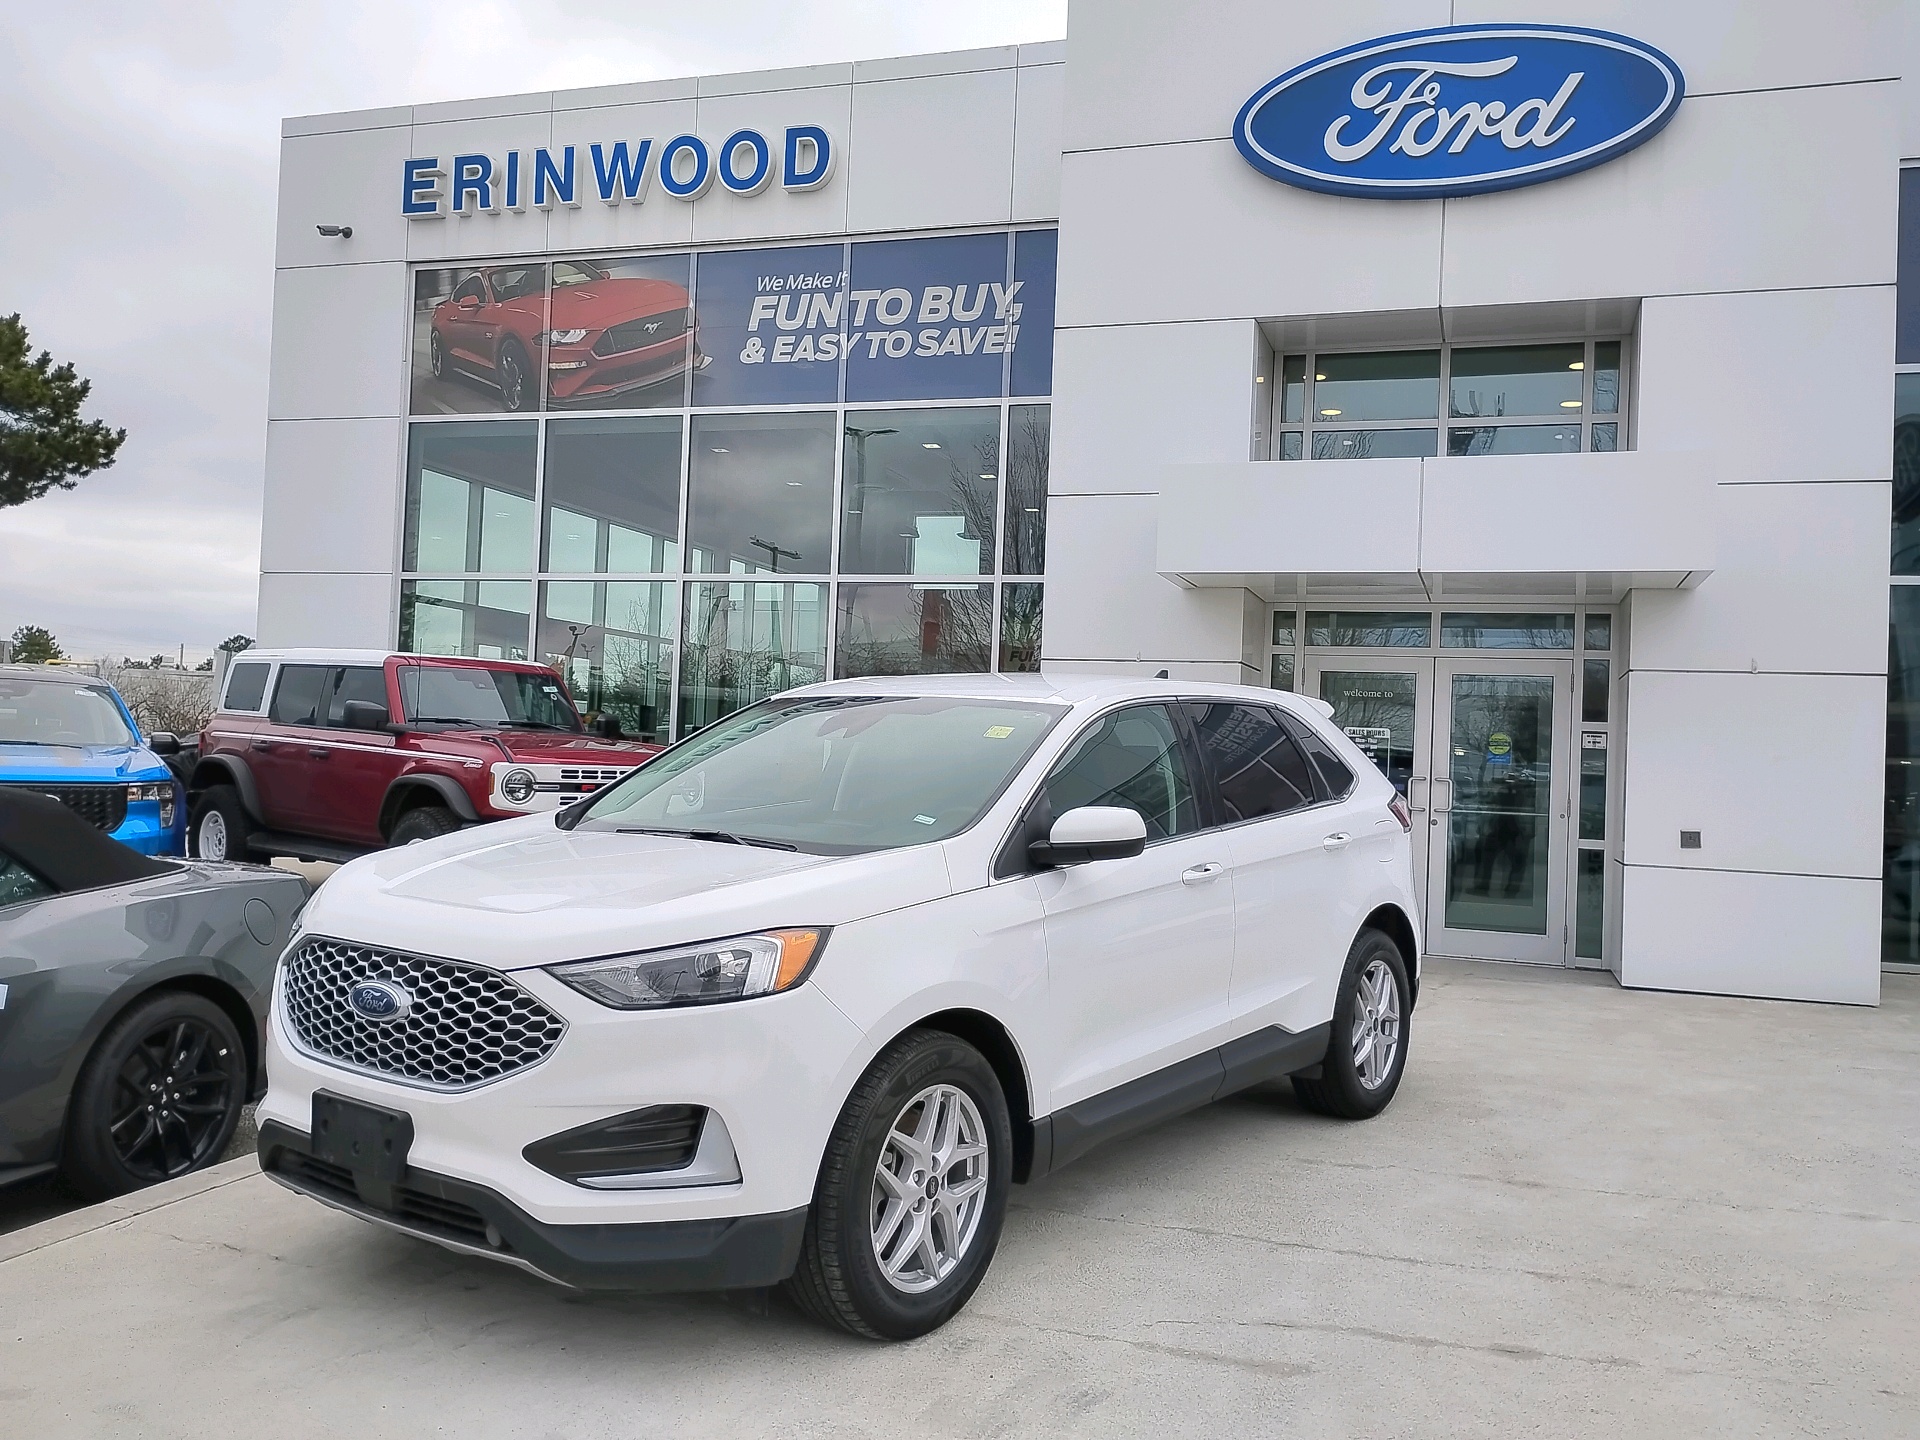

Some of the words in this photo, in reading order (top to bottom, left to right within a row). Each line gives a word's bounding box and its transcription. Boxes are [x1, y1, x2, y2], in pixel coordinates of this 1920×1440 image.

[1323, 55, 1585, 163] Ford
[402, 123, 836, 219] ERINWOOD
[757, 275, 783, 292] We
[786, 272, 833, 291] Make
[836, 270, 849, 287] It
[748, 292, 844, 331] FUN
[849, 288, 913, 327] TO
[739, 336, 765, 364] &
[771, 332, 863, 363] EASY
[865, 330, 912, 359] TO
[914, 324, 1020, 357] SAVE!
[1343, 688, 1382, 698] welcome
[1384, 690, 1394, 698] to
[1347, 728, 1366, 736] SALES
[358, 988, 388, 1012] Ford
